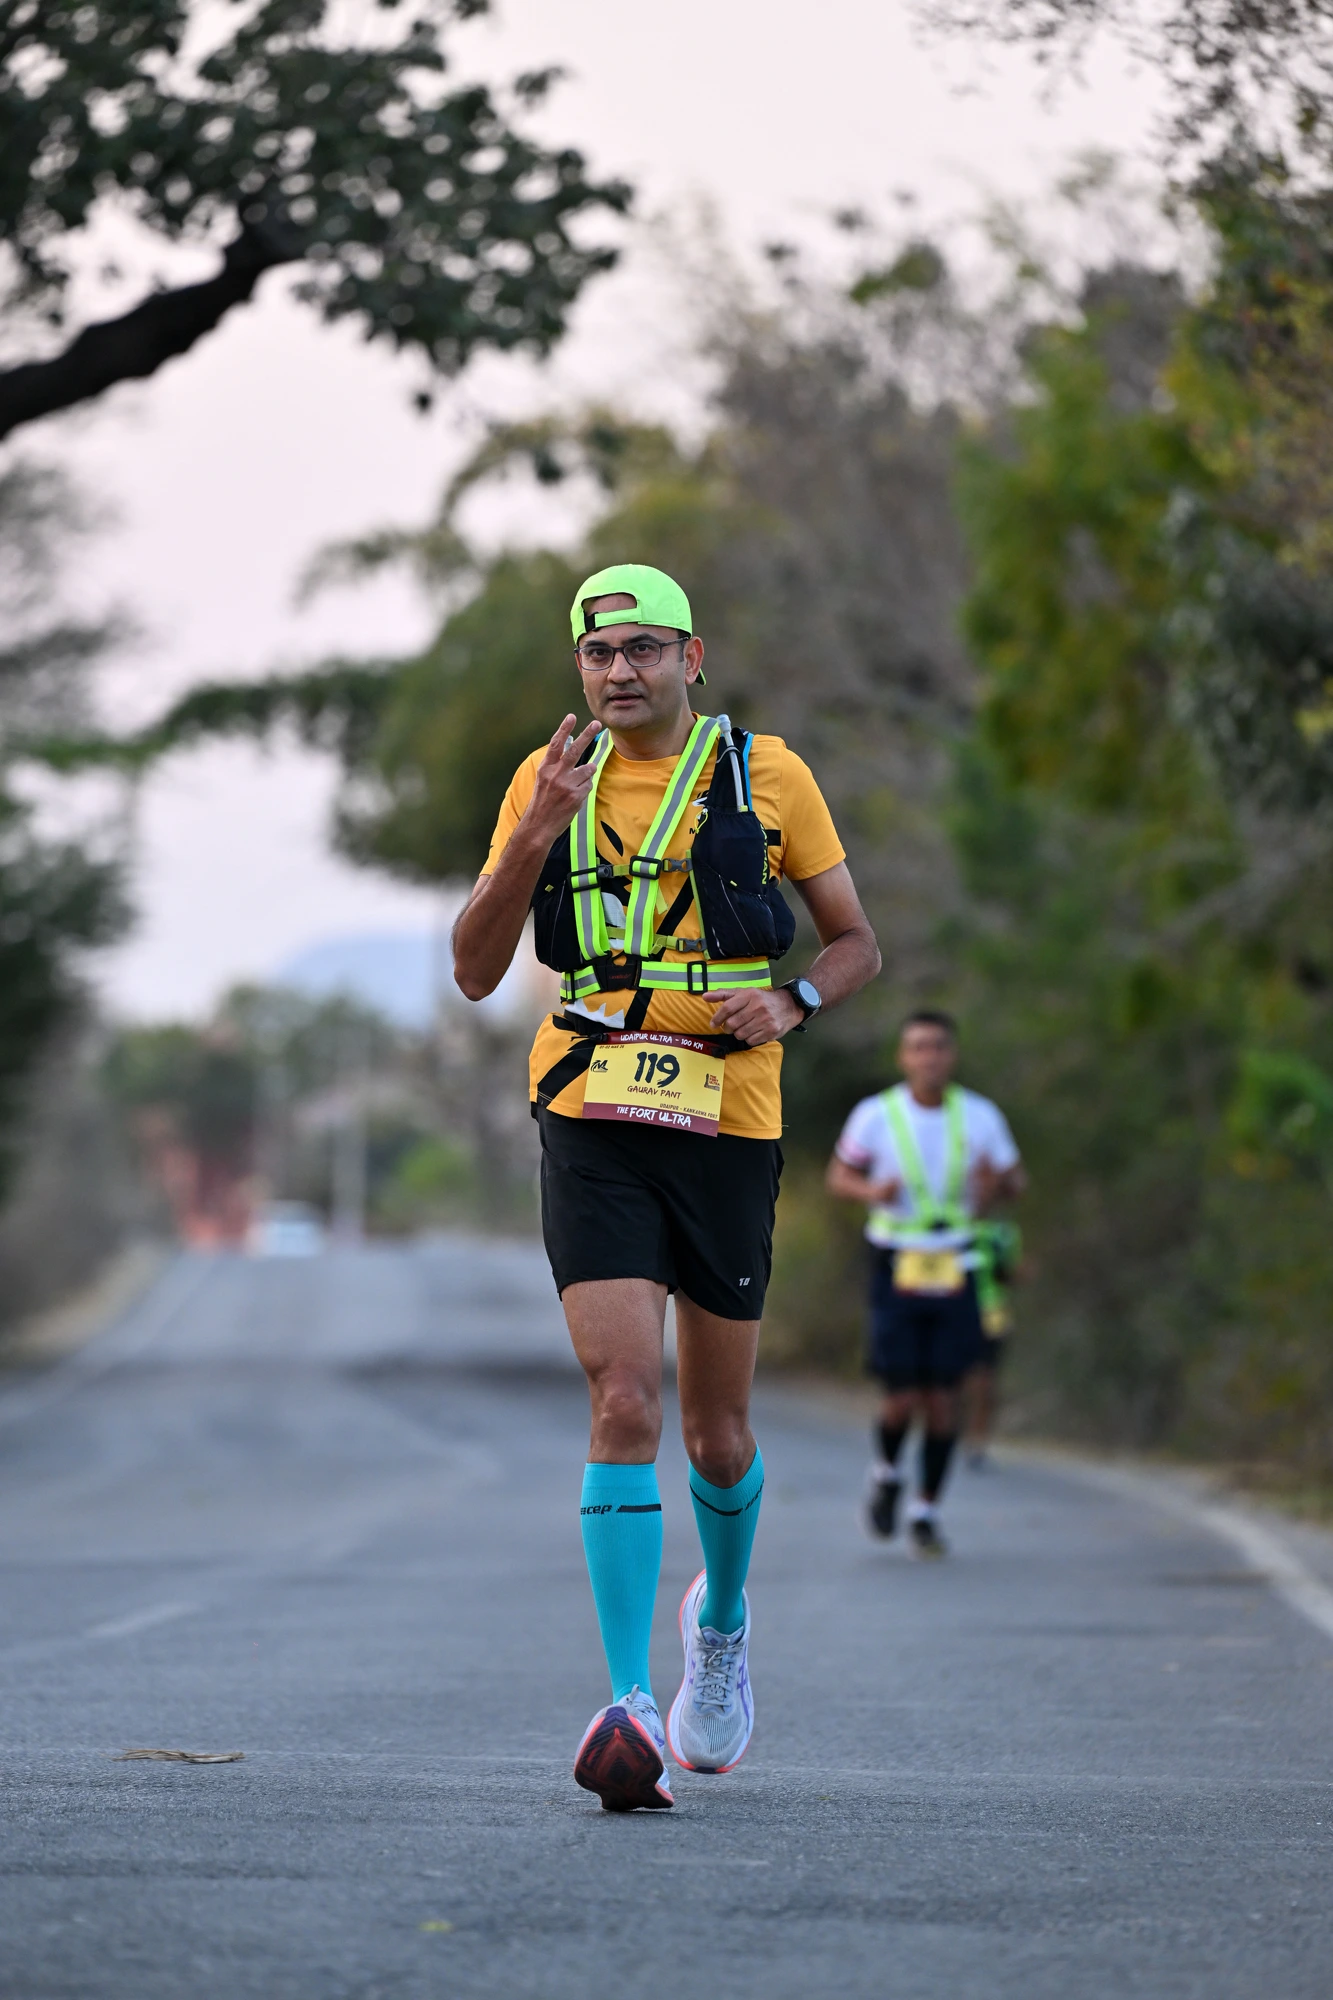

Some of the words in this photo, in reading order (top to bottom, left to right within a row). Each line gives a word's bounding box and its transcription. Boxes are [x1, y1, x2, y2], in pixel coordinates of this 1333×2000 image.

[621, 1033, 648, 1042] UDAIPUR
[650, 1034, 672, 1044] ULTRA
[681, 1038, 692, 1046] 100
[693, 1042, 704, 1050] KM
[634, 1051, 680, 1088] 119
[627, 1085, 659, 1096] GAURAV
[660, 1089, 682, 1100] PANT
[617, 1106, 629, 1114] THE
[629, 1107, 657, 1121] FORT
[658, 1112, 692, 1128] ULTRA
[587, 1505, 612, 1515] cep
